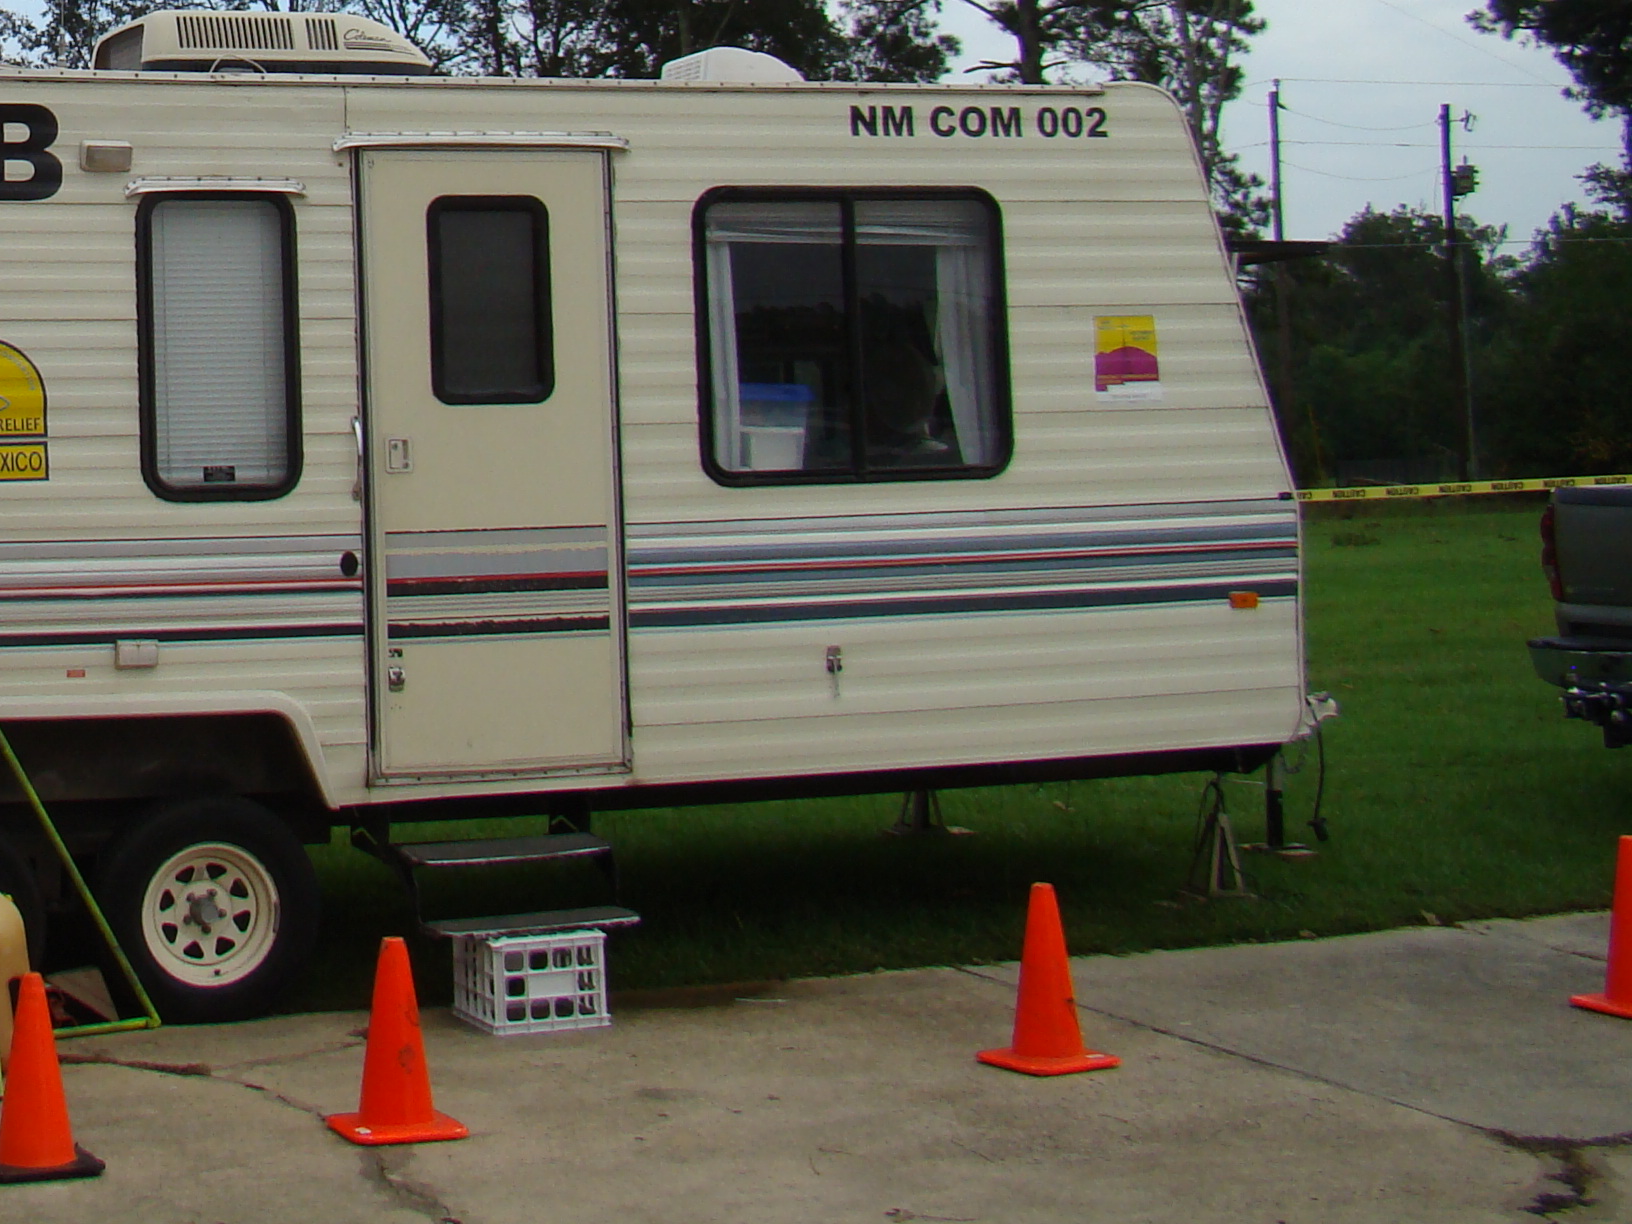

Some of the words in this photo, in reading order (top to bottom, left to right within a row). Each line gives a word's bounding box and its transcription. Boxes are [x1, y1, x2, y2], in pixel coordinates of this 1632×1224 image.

[849, 105, 915, 137] NM
[930, 105, 1023, 138] COM
[1036, 106, 1109, 138] 002
